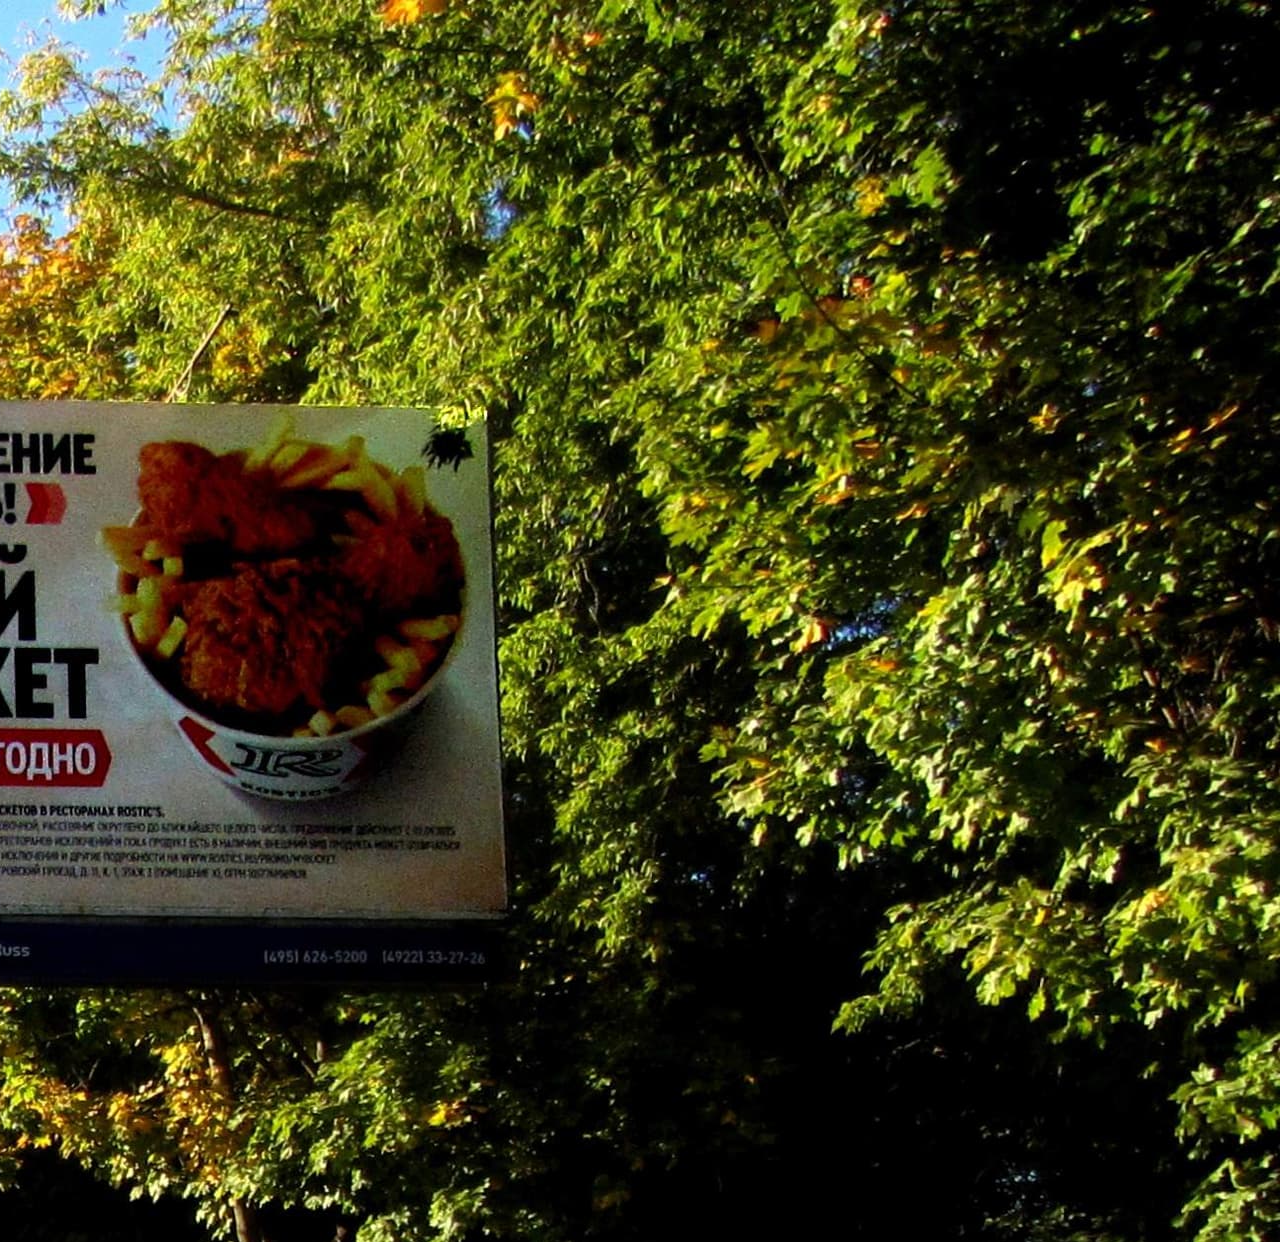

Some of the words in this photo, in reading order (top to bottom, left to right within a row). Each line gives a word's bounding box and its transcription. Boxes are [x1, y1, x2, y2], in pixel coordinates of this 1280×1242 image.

[40, 805, 47, 816] В
[49, 805, 115, 817] РЕСТОРАНАХ
[303, 950, 368, 964] 626-5200
